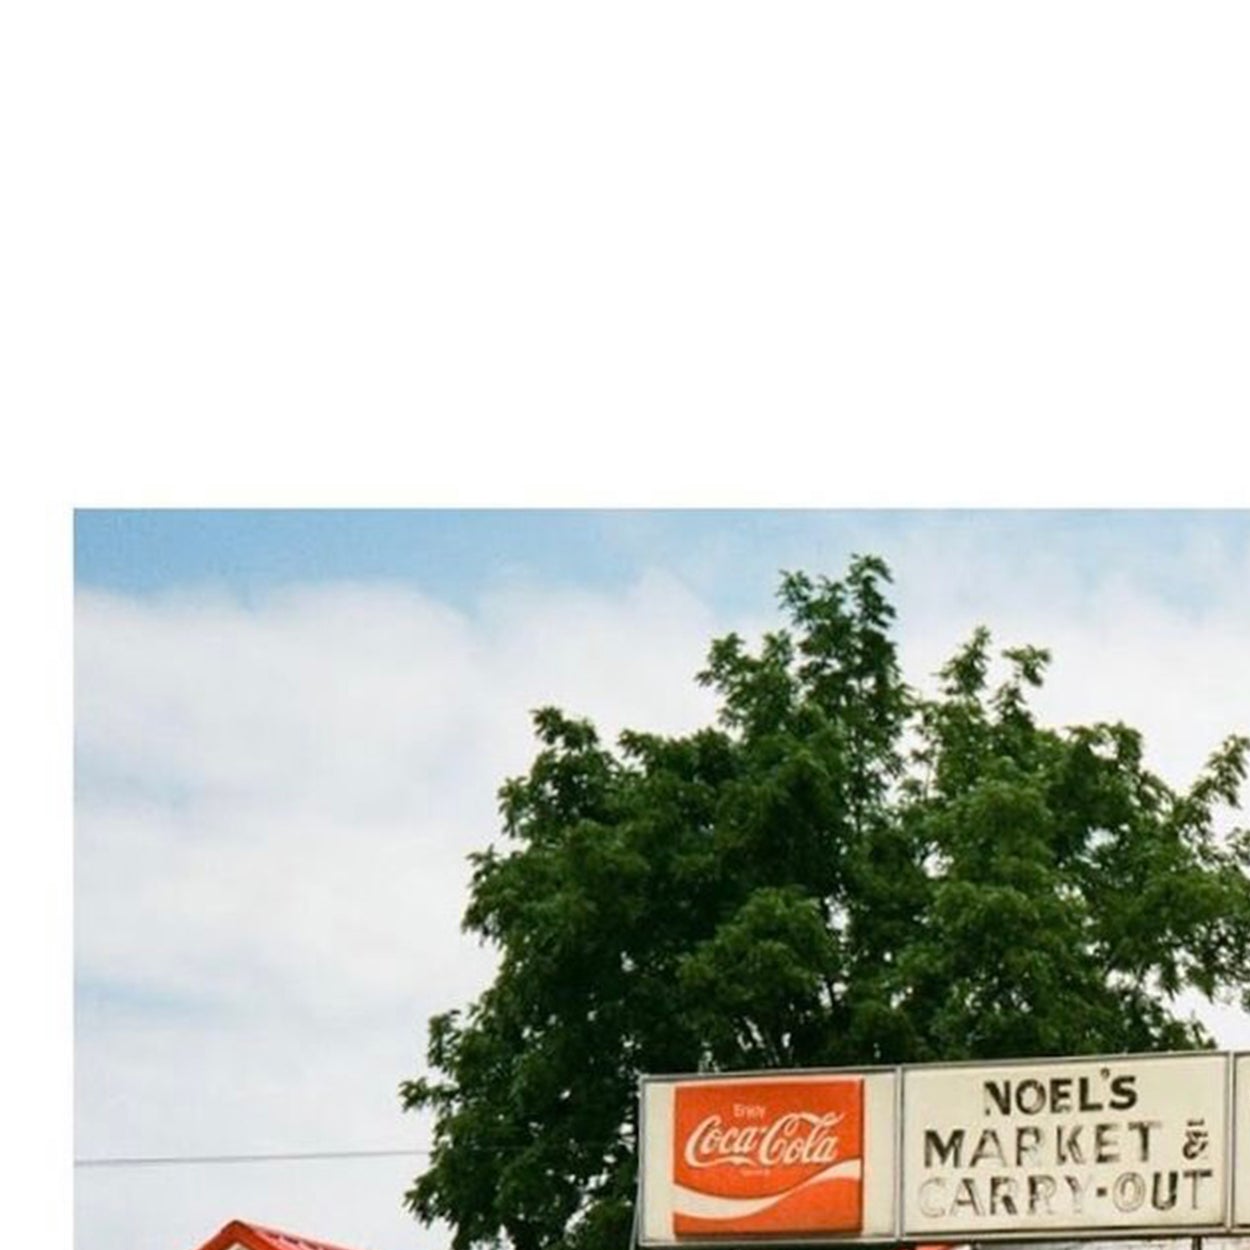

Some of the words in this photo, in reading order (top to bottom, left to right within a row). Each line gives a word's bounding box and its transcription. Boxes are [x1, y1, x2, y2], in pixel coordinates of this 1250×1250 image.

[984, 1067, 1138, 1117] NOEL'S
[683, 1111, 846, 1168] Coca-Cola
[924, 1121, 1164, 1169] MARKET
